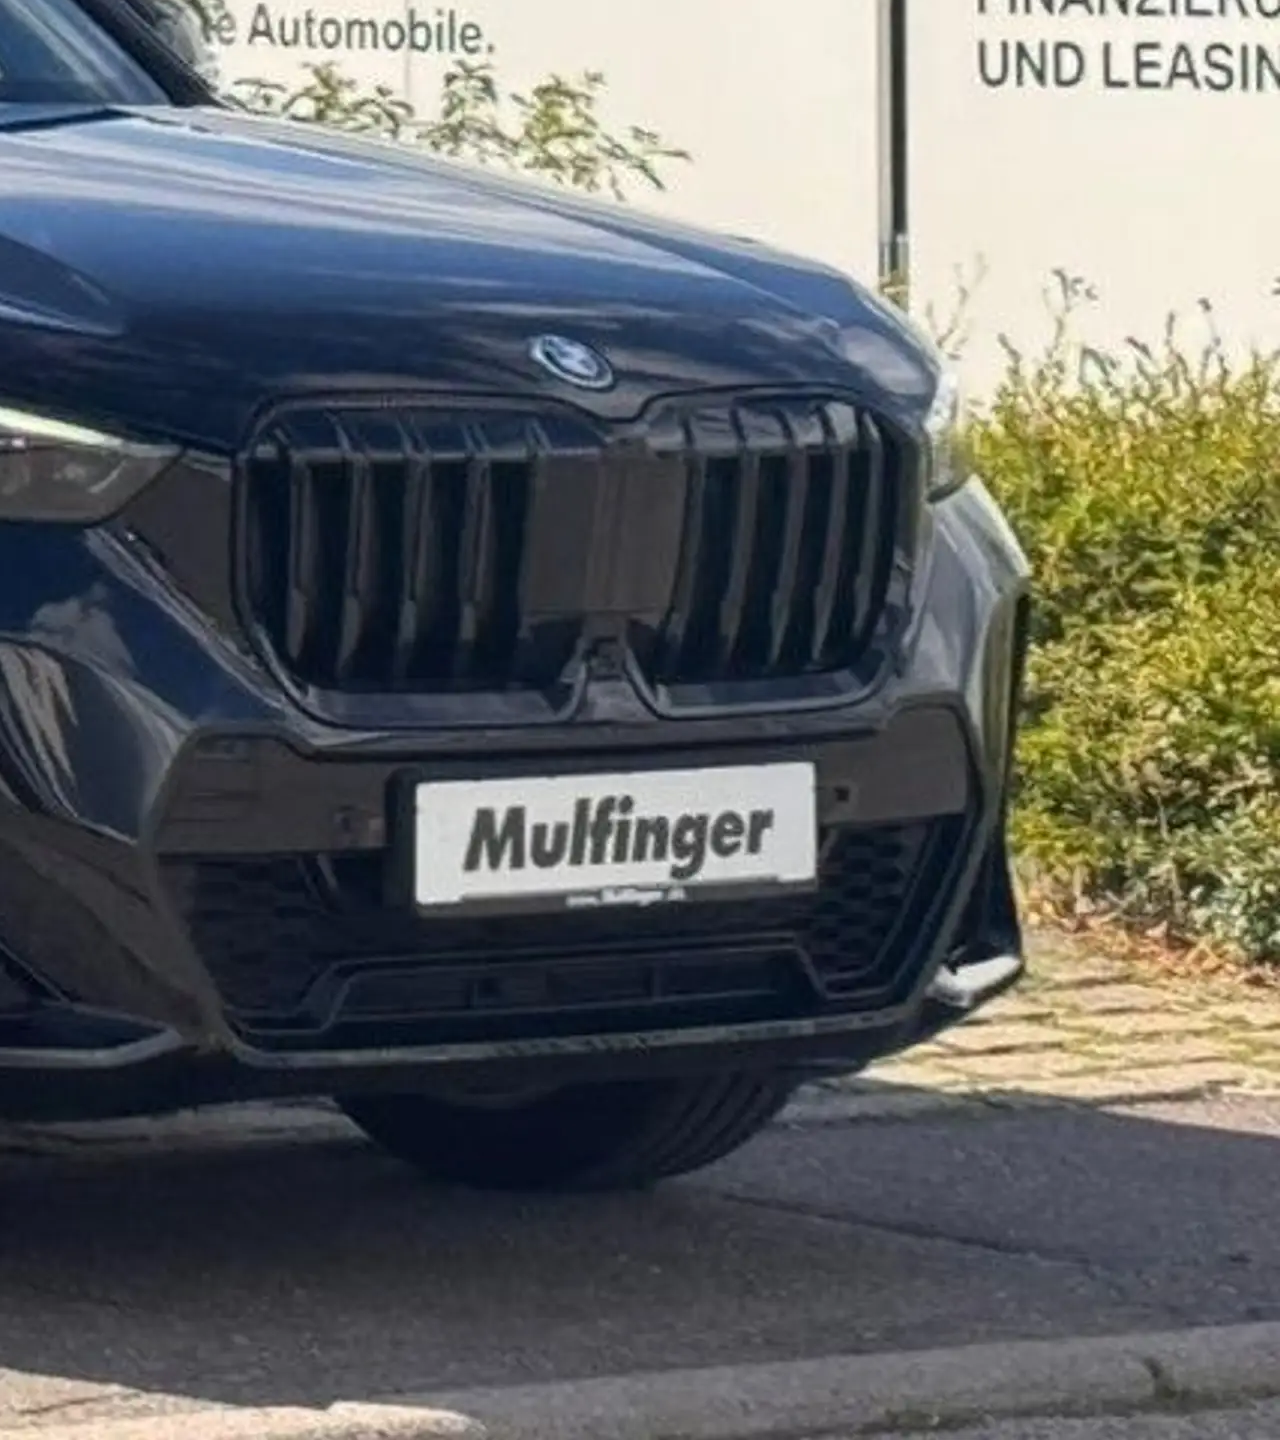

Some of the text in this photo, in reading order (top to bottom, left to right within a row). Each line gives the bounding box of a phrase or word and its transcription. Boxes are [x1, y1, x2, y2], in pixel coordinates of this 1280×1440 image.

[247, 2, 495, 55] Automobile.
[978, 40, 1280, 93] UND LEASIN
[462, 794, 775, 881] Mulfinger
